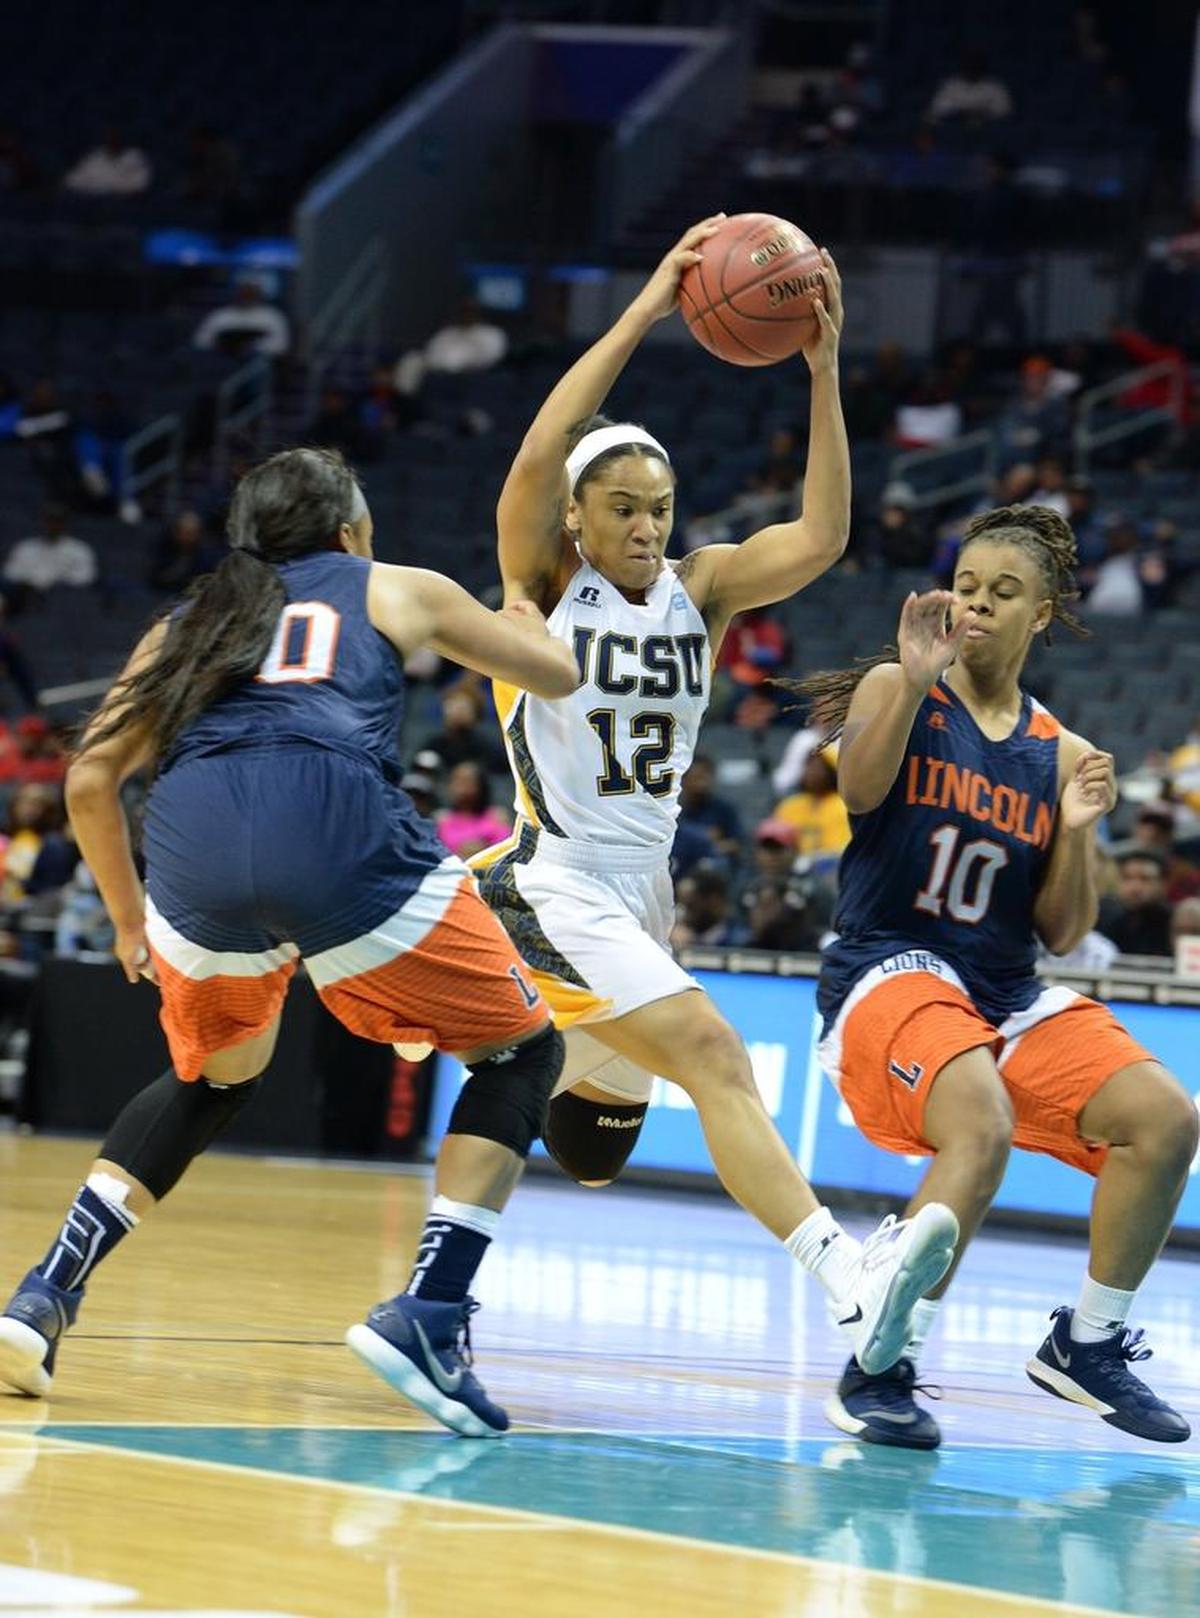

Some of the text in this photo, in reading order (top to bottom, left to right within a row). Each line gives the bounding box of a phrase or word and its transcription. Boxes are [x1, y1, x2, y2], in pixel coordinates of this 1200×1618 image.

[256, 601, 341, 683] 0
[586, 707, 677, 798] 12
[906, 755, 1055, 850] LINCOLN
[912, 823, 1009, 927] 10
[881, 952, 943, 974] LIONS
[888, 1060, 926, 1092] L
